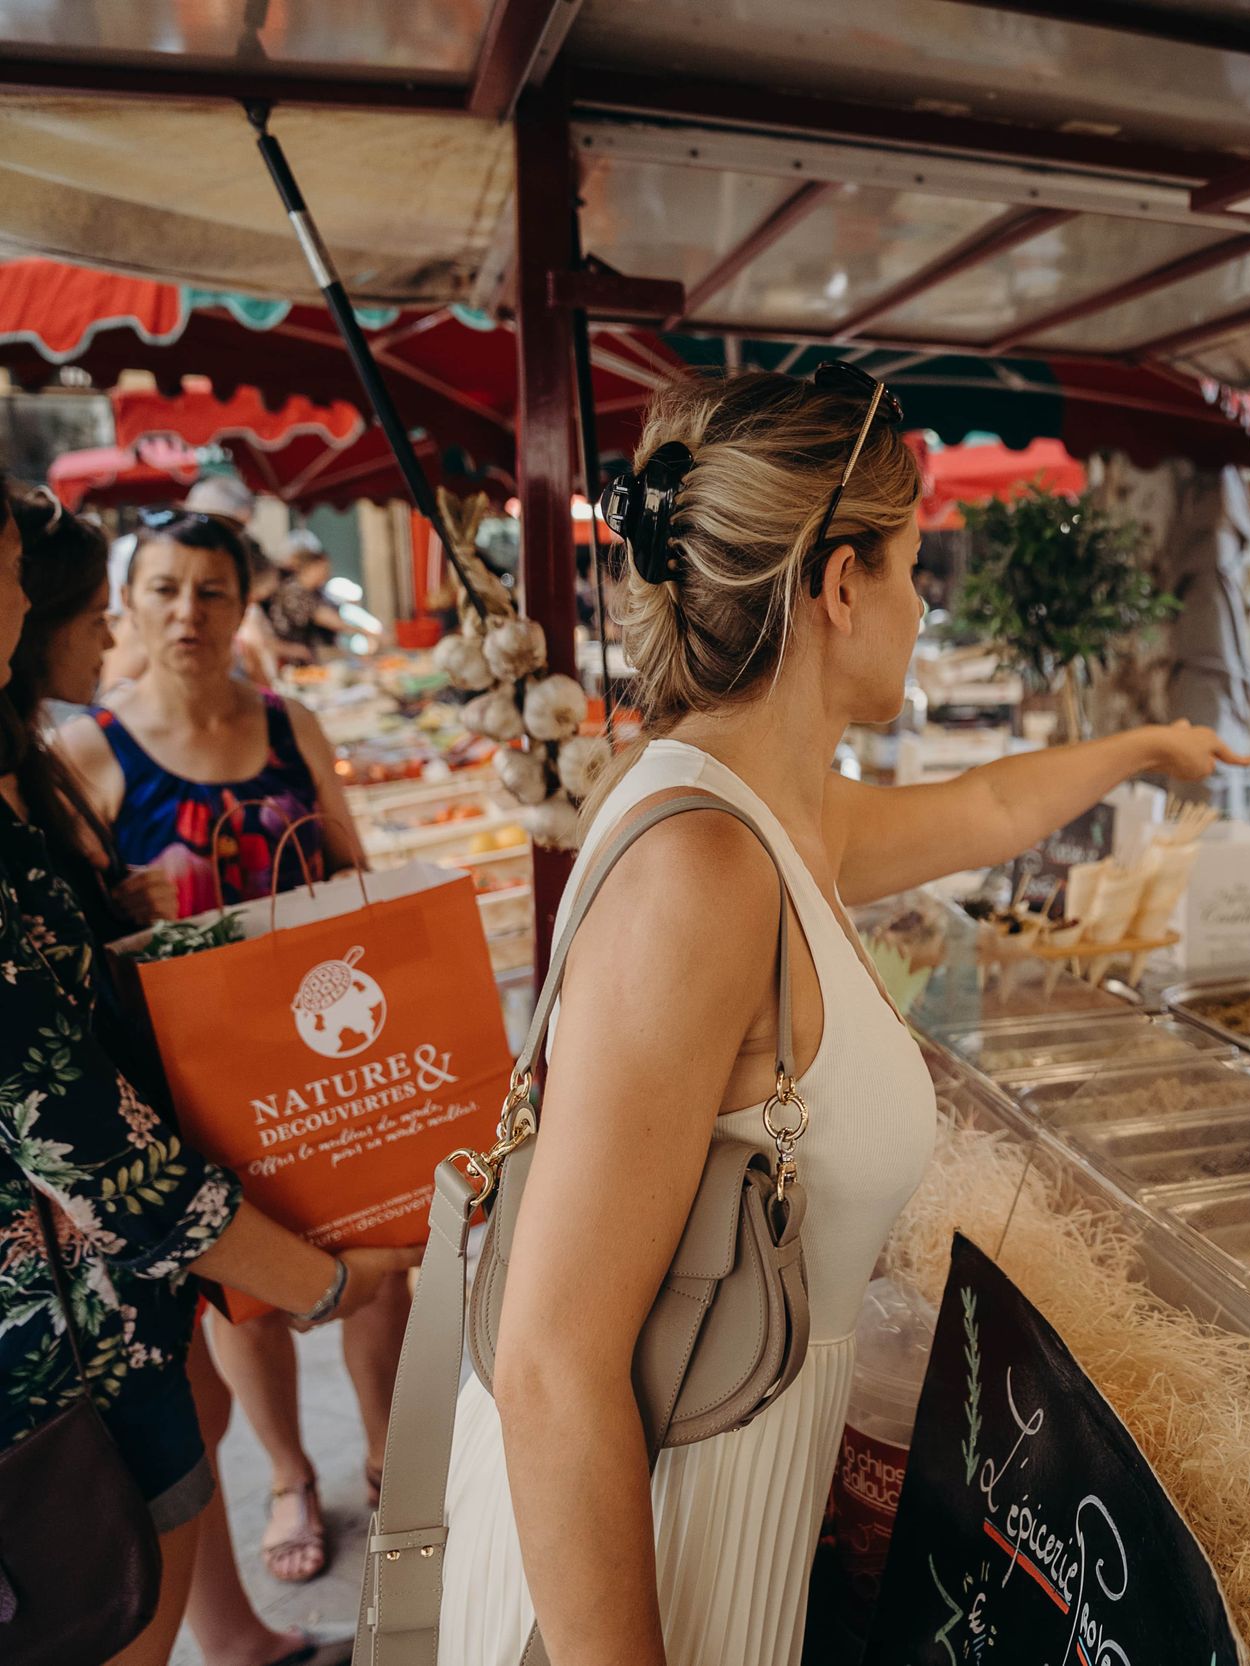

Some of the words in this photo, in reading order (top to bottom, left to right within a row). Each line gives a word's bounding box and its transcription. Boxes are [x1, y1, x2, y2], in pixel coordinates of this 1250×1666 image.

[250, 1052, 412, 1126] NATURE
[413, 1043, 460, 1092] &
[258, 1080, 418, 1147] DECOUVERTES
[844, 1434, 855, 1463] la
[857, 1449, 906, 1487] chips
